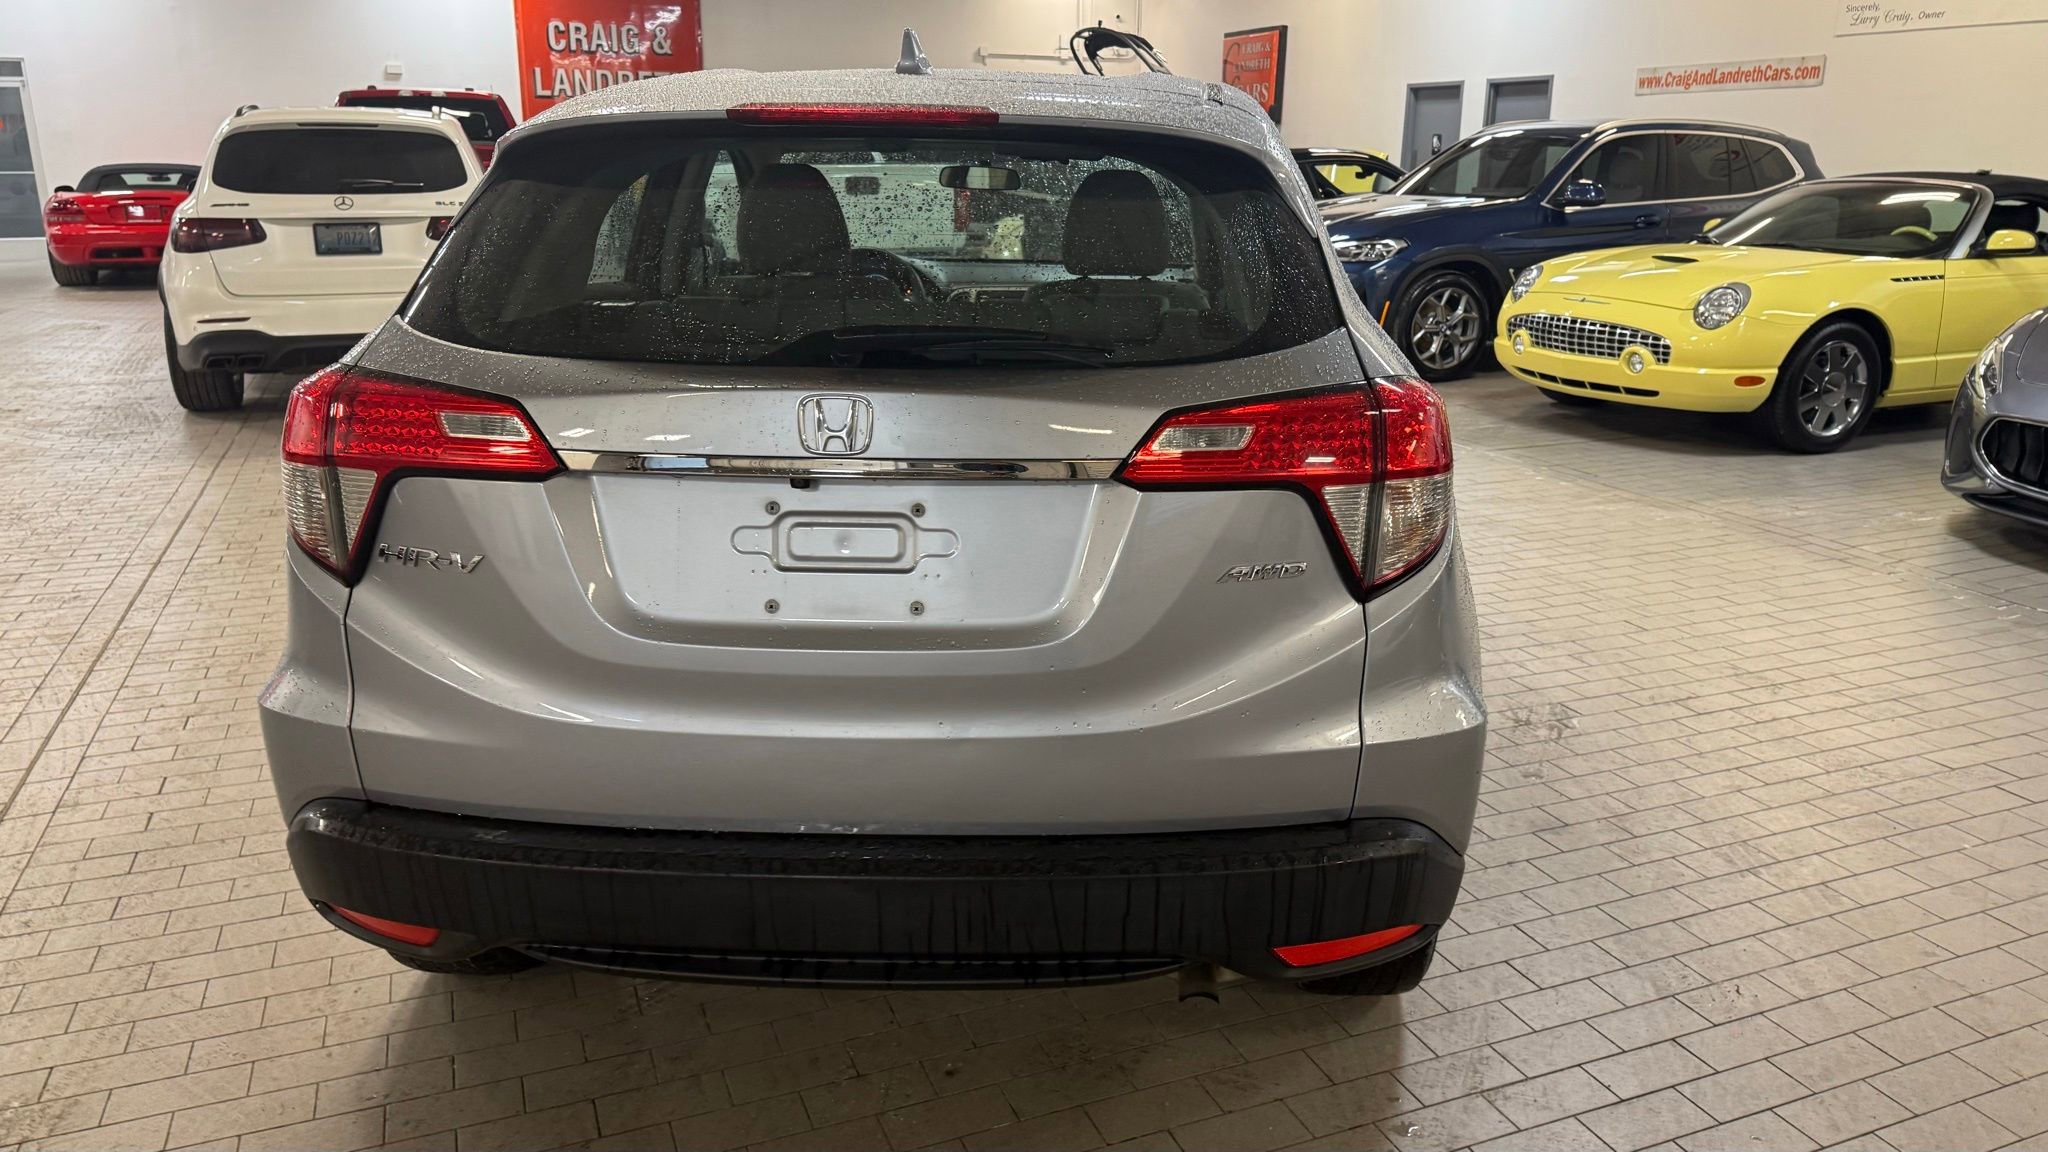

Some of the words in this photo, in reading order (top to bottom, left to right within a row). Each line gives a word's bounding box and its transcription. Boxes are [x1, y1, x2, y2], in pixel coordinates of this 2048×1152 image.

[1845, 2, 1880, 13] Sincerely,
[1849, 12, 1880, 28] Larry
[1883, 9, 1913, 26] Craig,
[1918, 10, 1946, 20] Owner
[547, 20, 641, 54] CRAIG
[652, 26, 673, 55] &
[1638, 64, 1821, 90] www.CraigAndLandrethCars.com
[379, 543, 484, 573] HR-V
[1216, 561, 1307, 584] AWD
